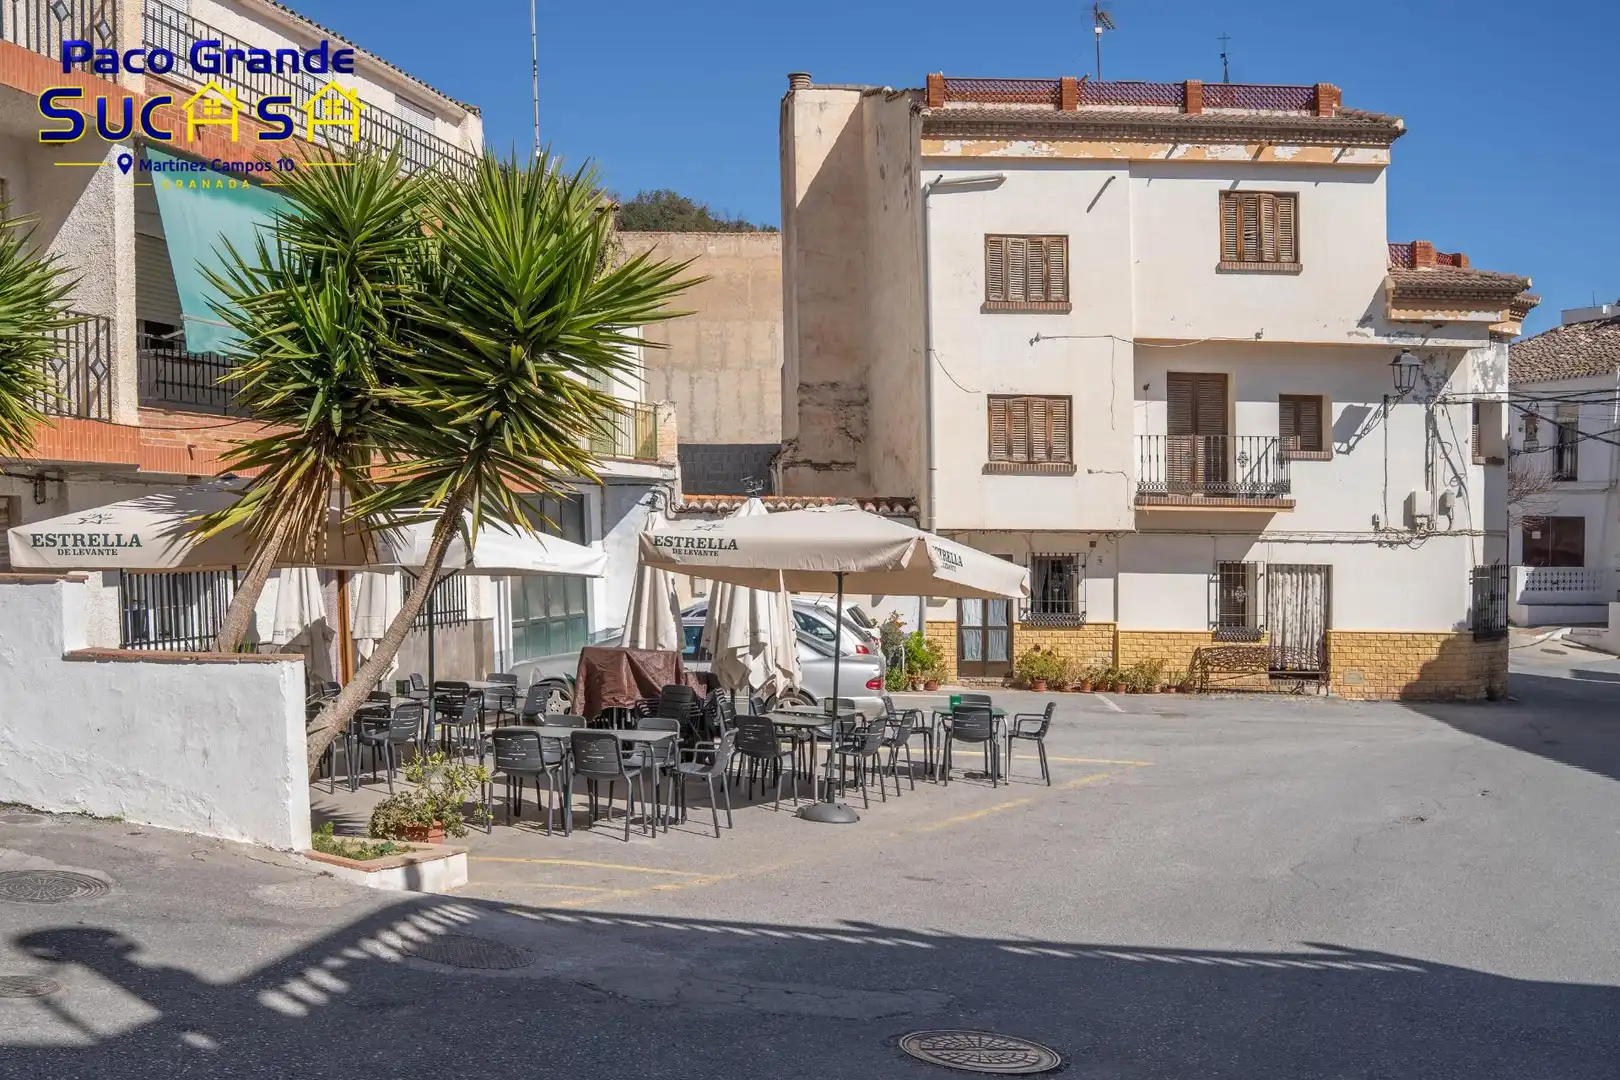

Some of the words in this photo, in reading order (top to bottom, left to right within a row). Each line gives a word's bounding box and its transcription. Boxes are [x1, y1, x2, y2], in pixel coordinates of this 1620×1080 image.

[30, 533, 142, 548] ESTRELLA
[653, 535, 739, 551] ESTRELLA
[57, 548, 71, 556] DE
[72, 548, 118, 556] LEVANTE
[683, 548, 719, 557] LEVANTE
